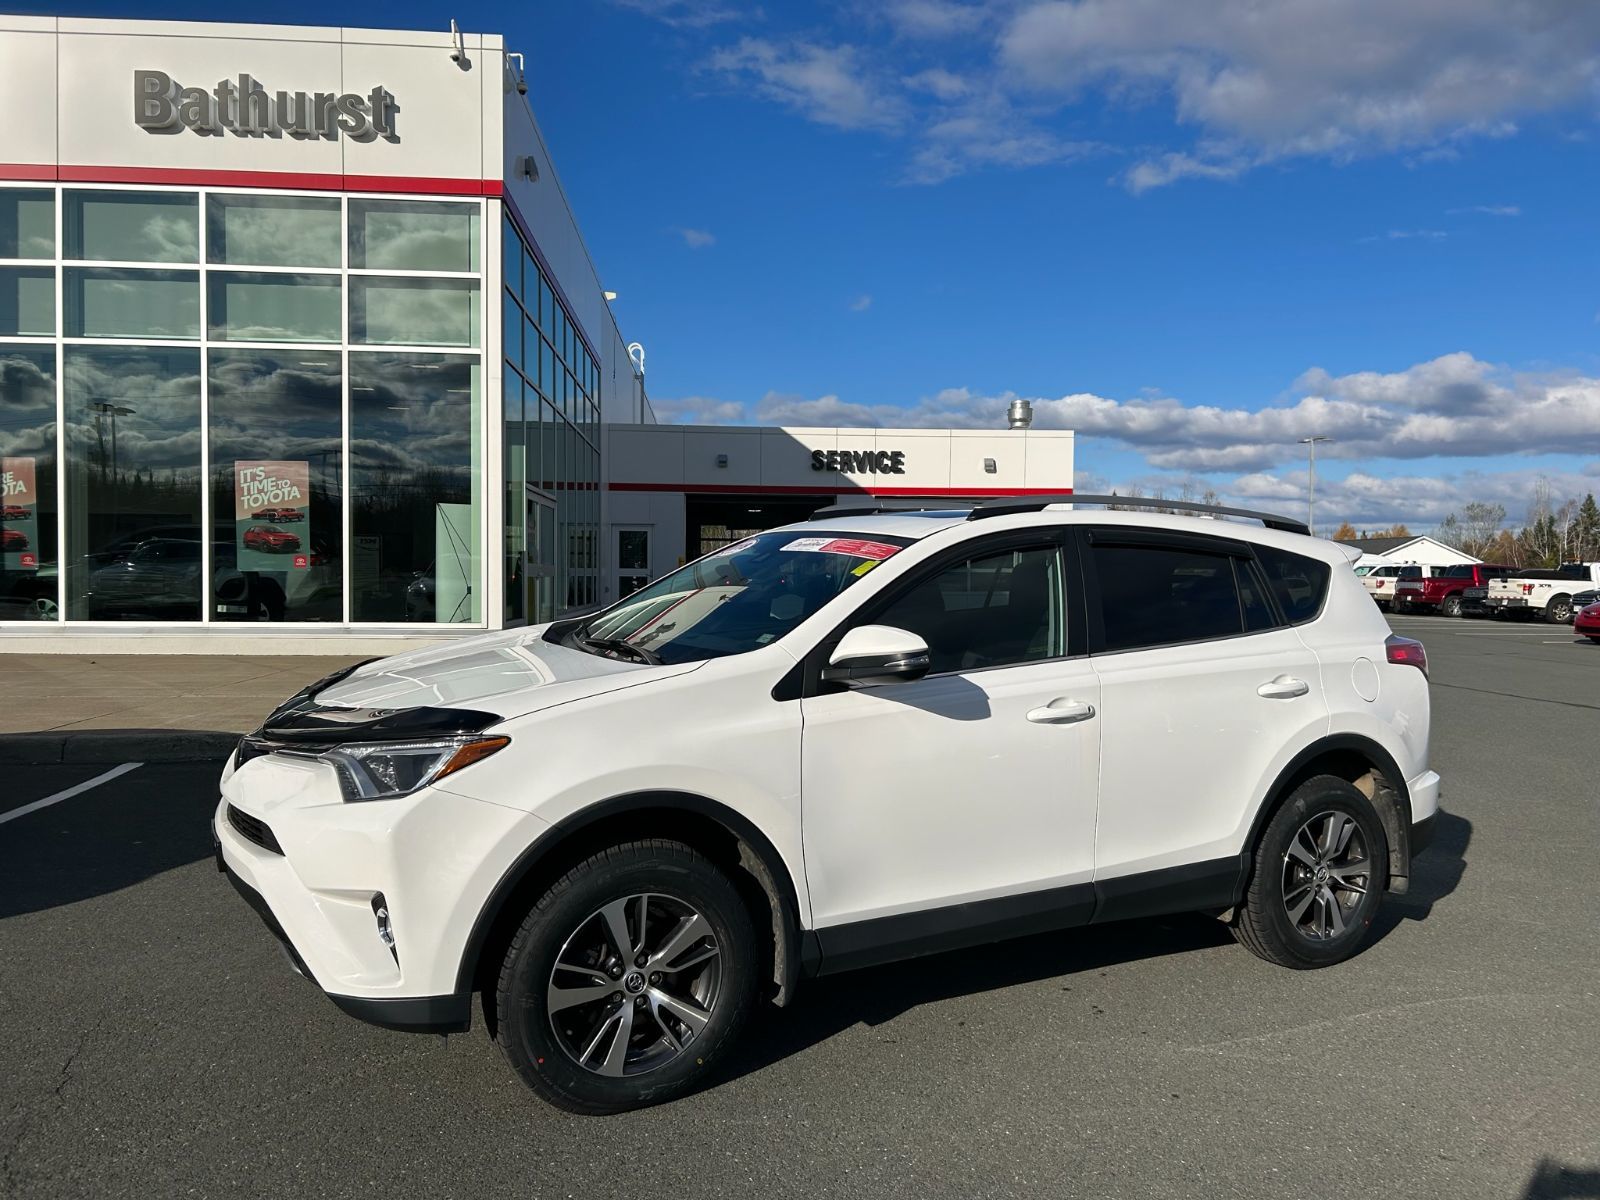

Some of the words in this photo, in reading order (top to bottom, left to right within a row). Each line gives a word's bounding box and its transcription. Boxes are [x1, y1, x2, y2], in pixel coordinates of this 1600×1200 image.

[134, 69, 398, 141] Bathurst
[811, 449, 905, 474] SERVICE
[240, 466, 265, 483] IT'S
[240, 477, 277, 496] TIME
[277, 479, 291, 489] TO
[240, 486, 301, 509] TOYOTA
